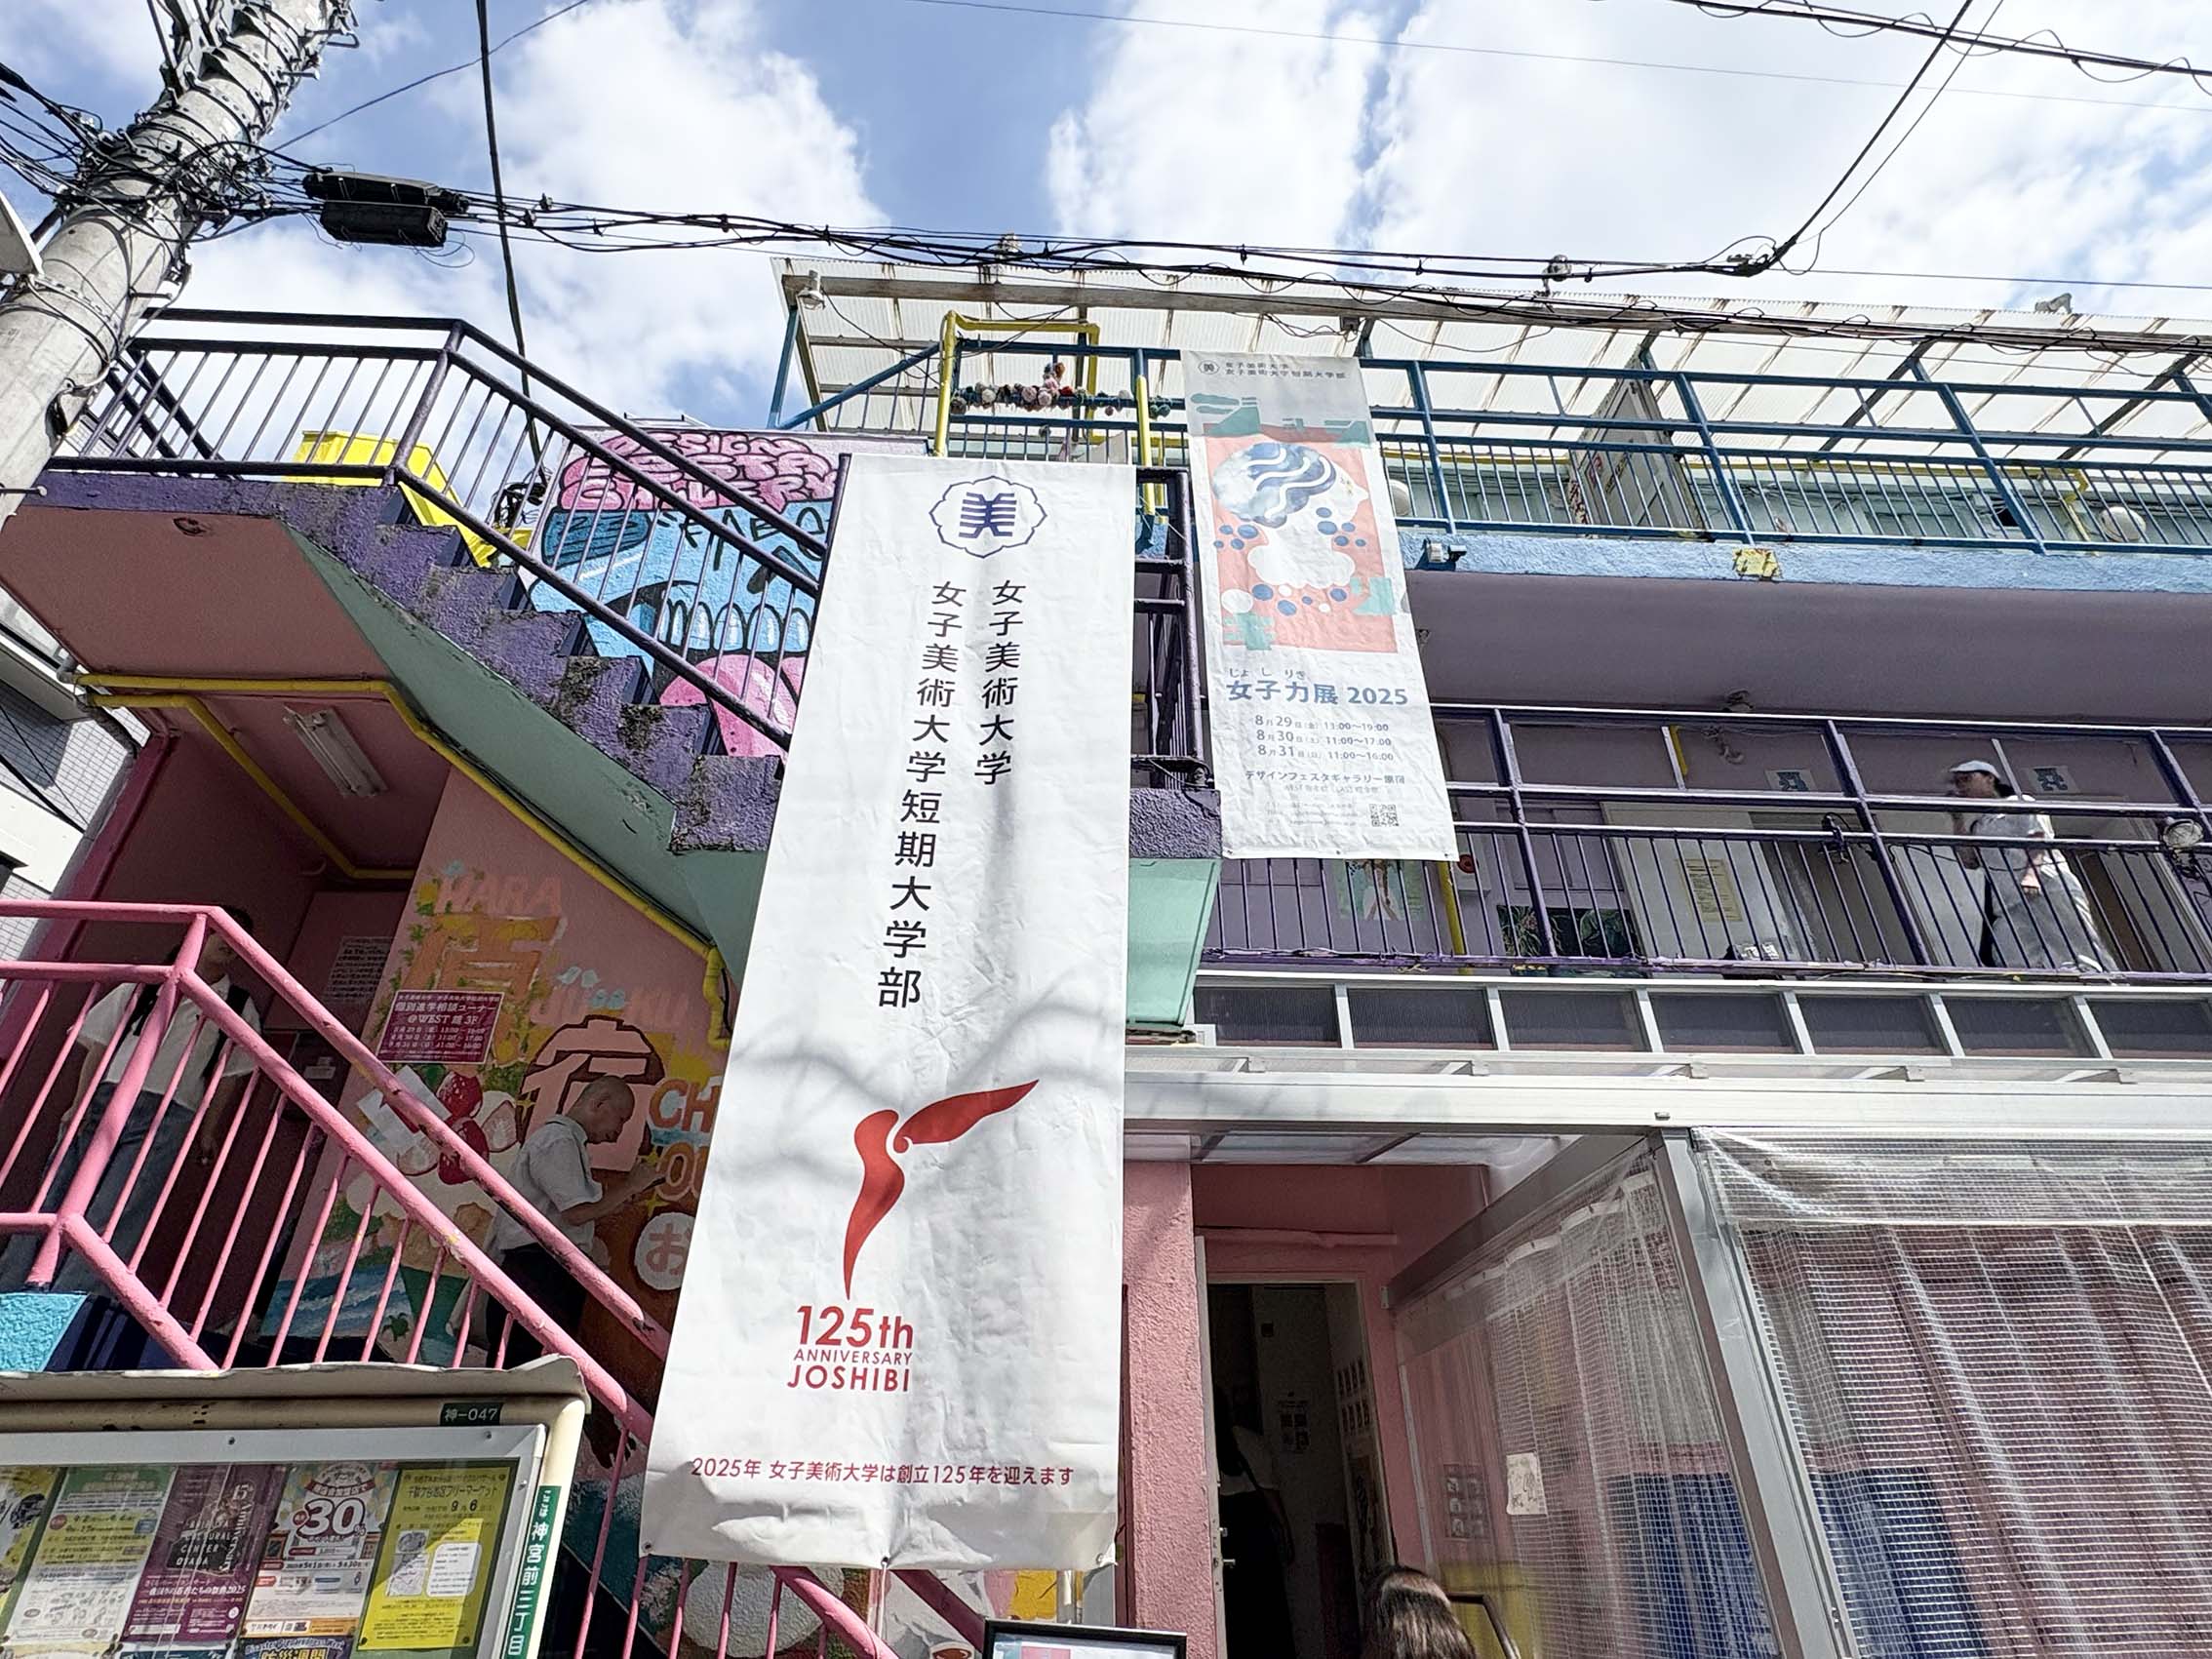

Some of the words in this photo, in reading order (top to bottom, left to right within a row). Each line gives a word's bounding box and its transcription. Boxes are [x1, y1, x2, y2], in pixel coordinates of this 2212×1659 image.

[974, 579, 1026, 785] 女子美術大学
[1226, 680, 1338, 705] 女子力展
[1347, 687, 1408, 705] 2025
[878, 580, 967, 1008] 女子美術大学短期大学部
[797, 1305, 914, 1349] 125th
[793, 1349, 913, 1365] ANNIVERSARY
[787, 1364, 910, 1392] JOSHIBI
[691, 1457, 762, 1480] 2025年
[769, 1459, 1075, 1486] 女子美術大学は創立125年を迎えます
[507, 1521, 549, 1656] 神宮前三丁目
